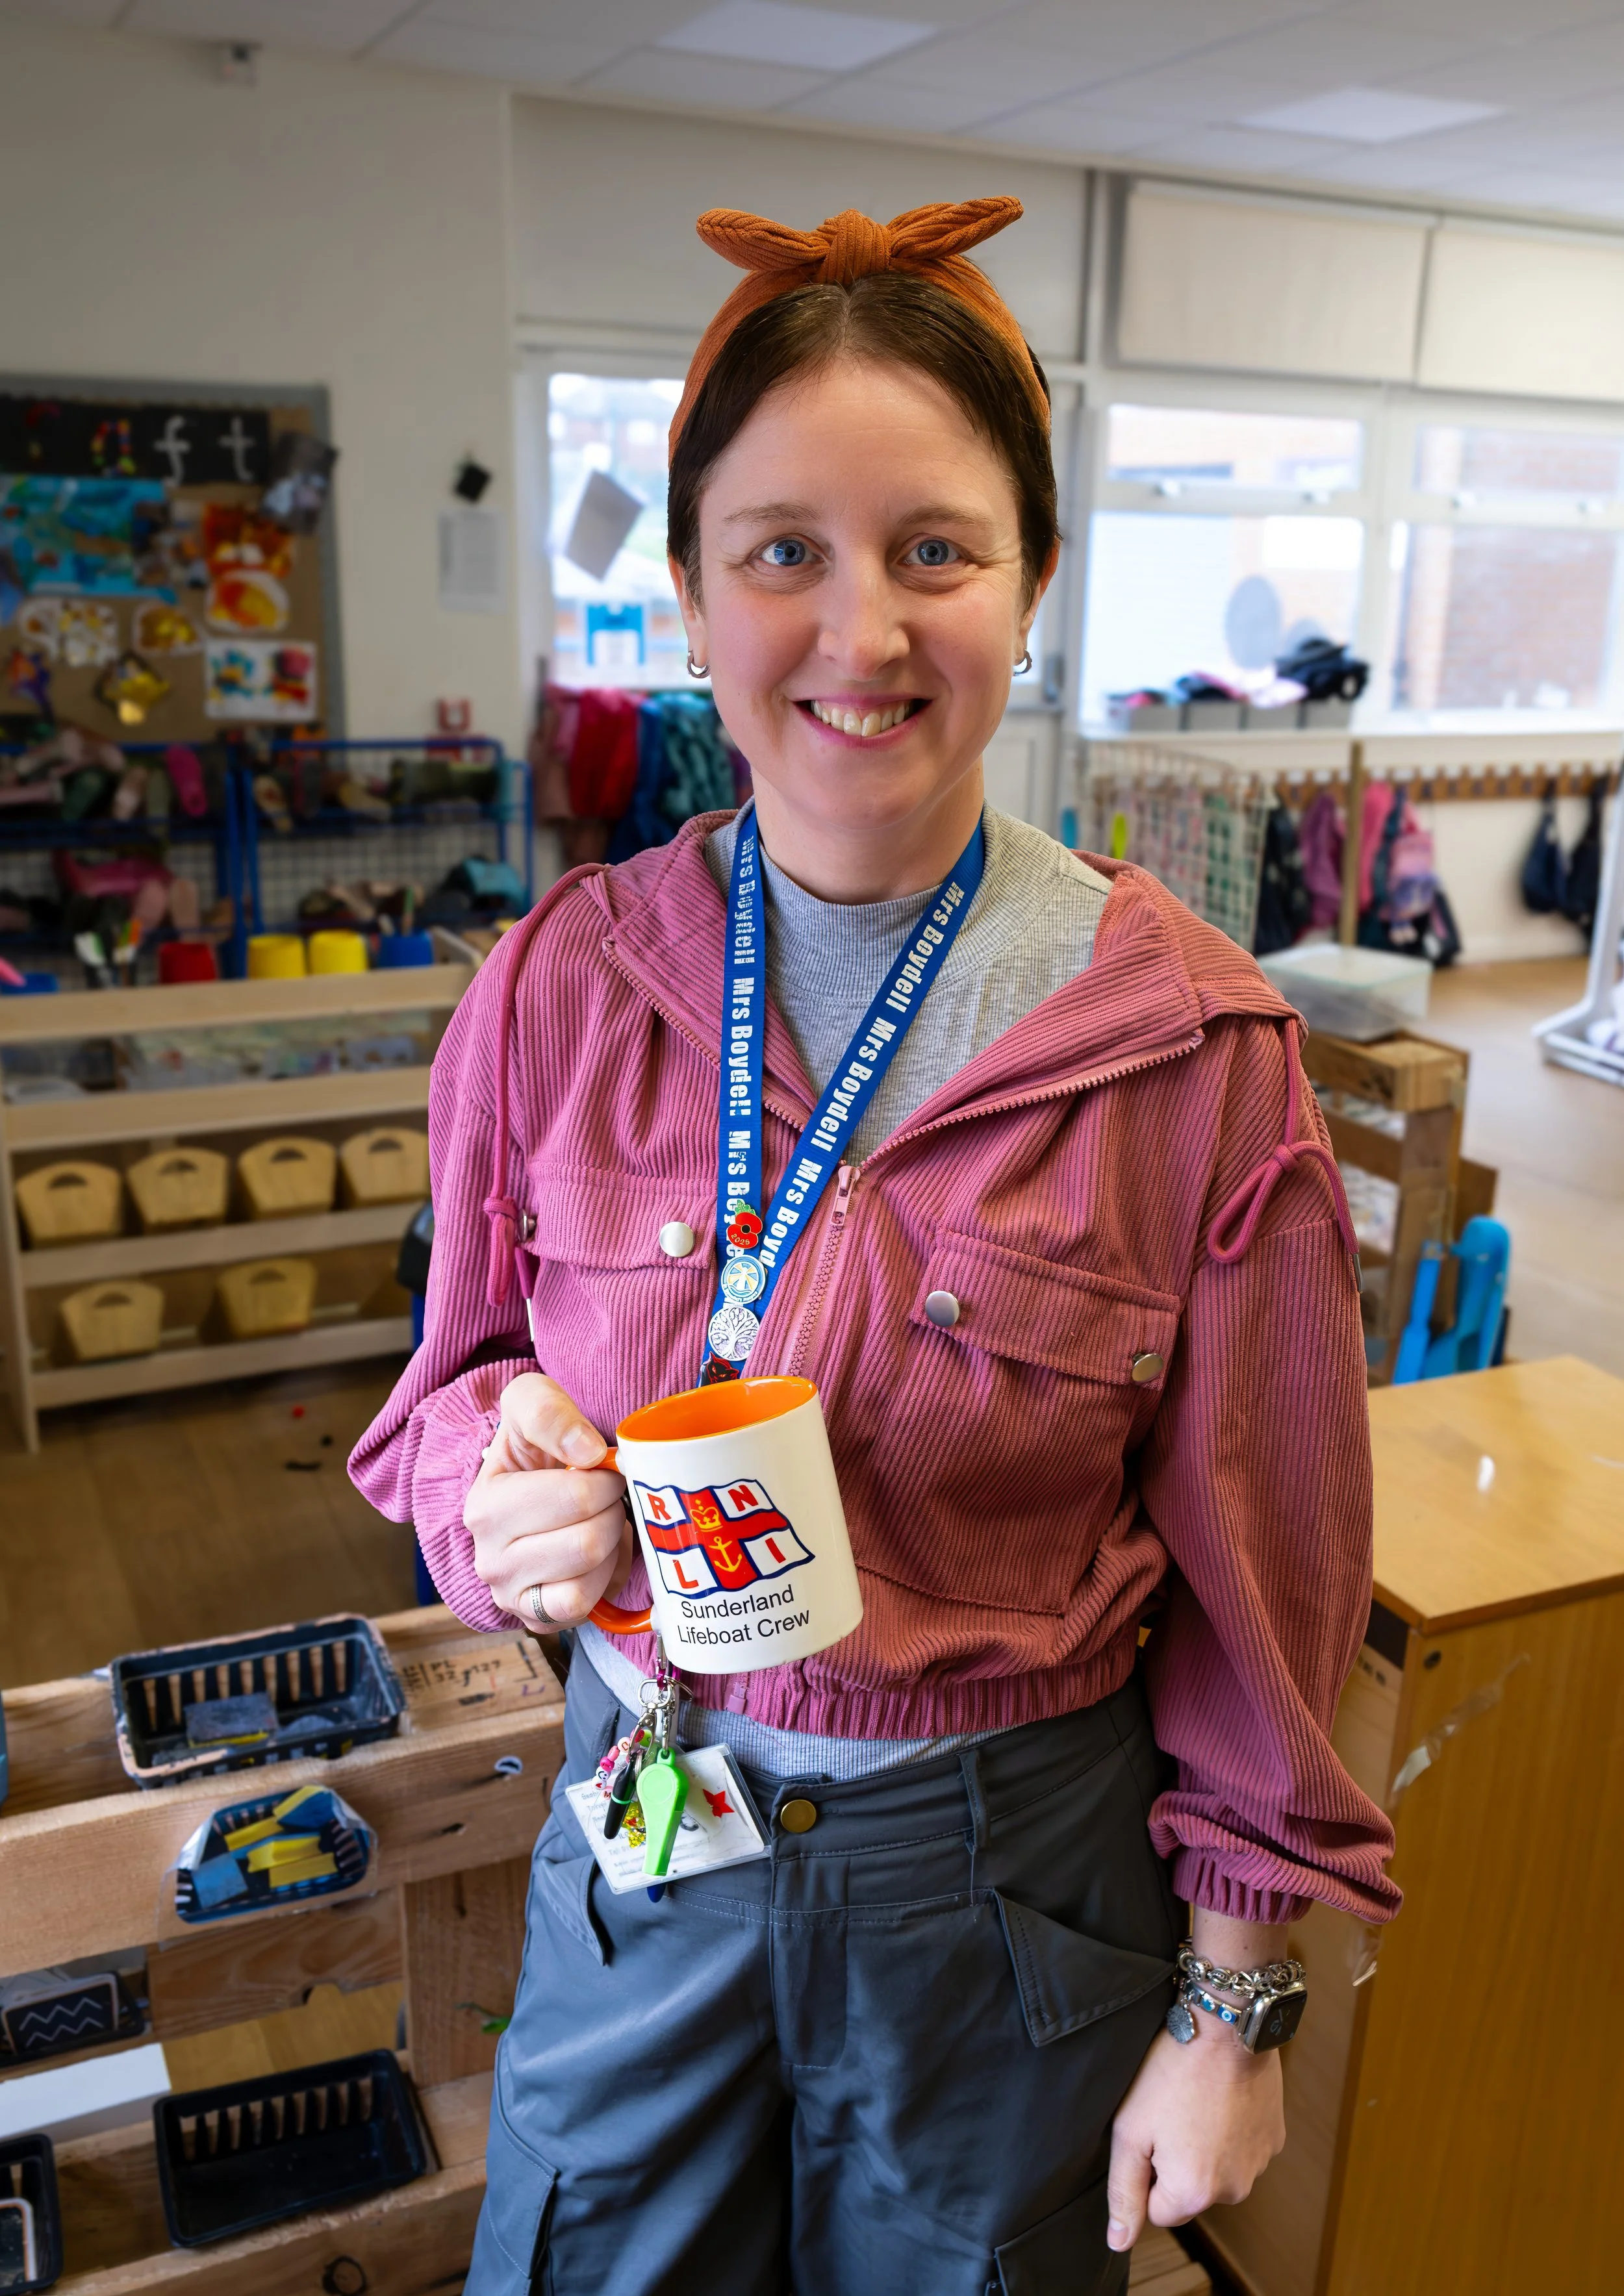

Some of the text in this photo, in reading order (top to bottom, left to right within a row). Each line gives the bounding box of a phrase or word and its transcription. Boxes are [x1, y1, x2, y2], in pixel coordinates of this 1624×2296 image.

[933, 881, 965, 926] Mrs
[885, 924, 944, 1013] Boydell
[731, 977, 754, 1020] Mrs
[859, 1016, 896, 1062] Mrs
[728, 1025, 753, 1116] Boydell
[811, 1061, 873, 1152] Boydell
[728, 1131, 750, 1175] Mrs
[786, 1157, 822, 1205] Mrs
[731, 1233, 750, 1245] 2025
[647, 1485, 759, 1520] R N
[672, 1537, 786, 1589] L I
[681, 1584, 794, 1619] Sunderland
[678, 1609, 810, 1645] Lifeboat Crew
